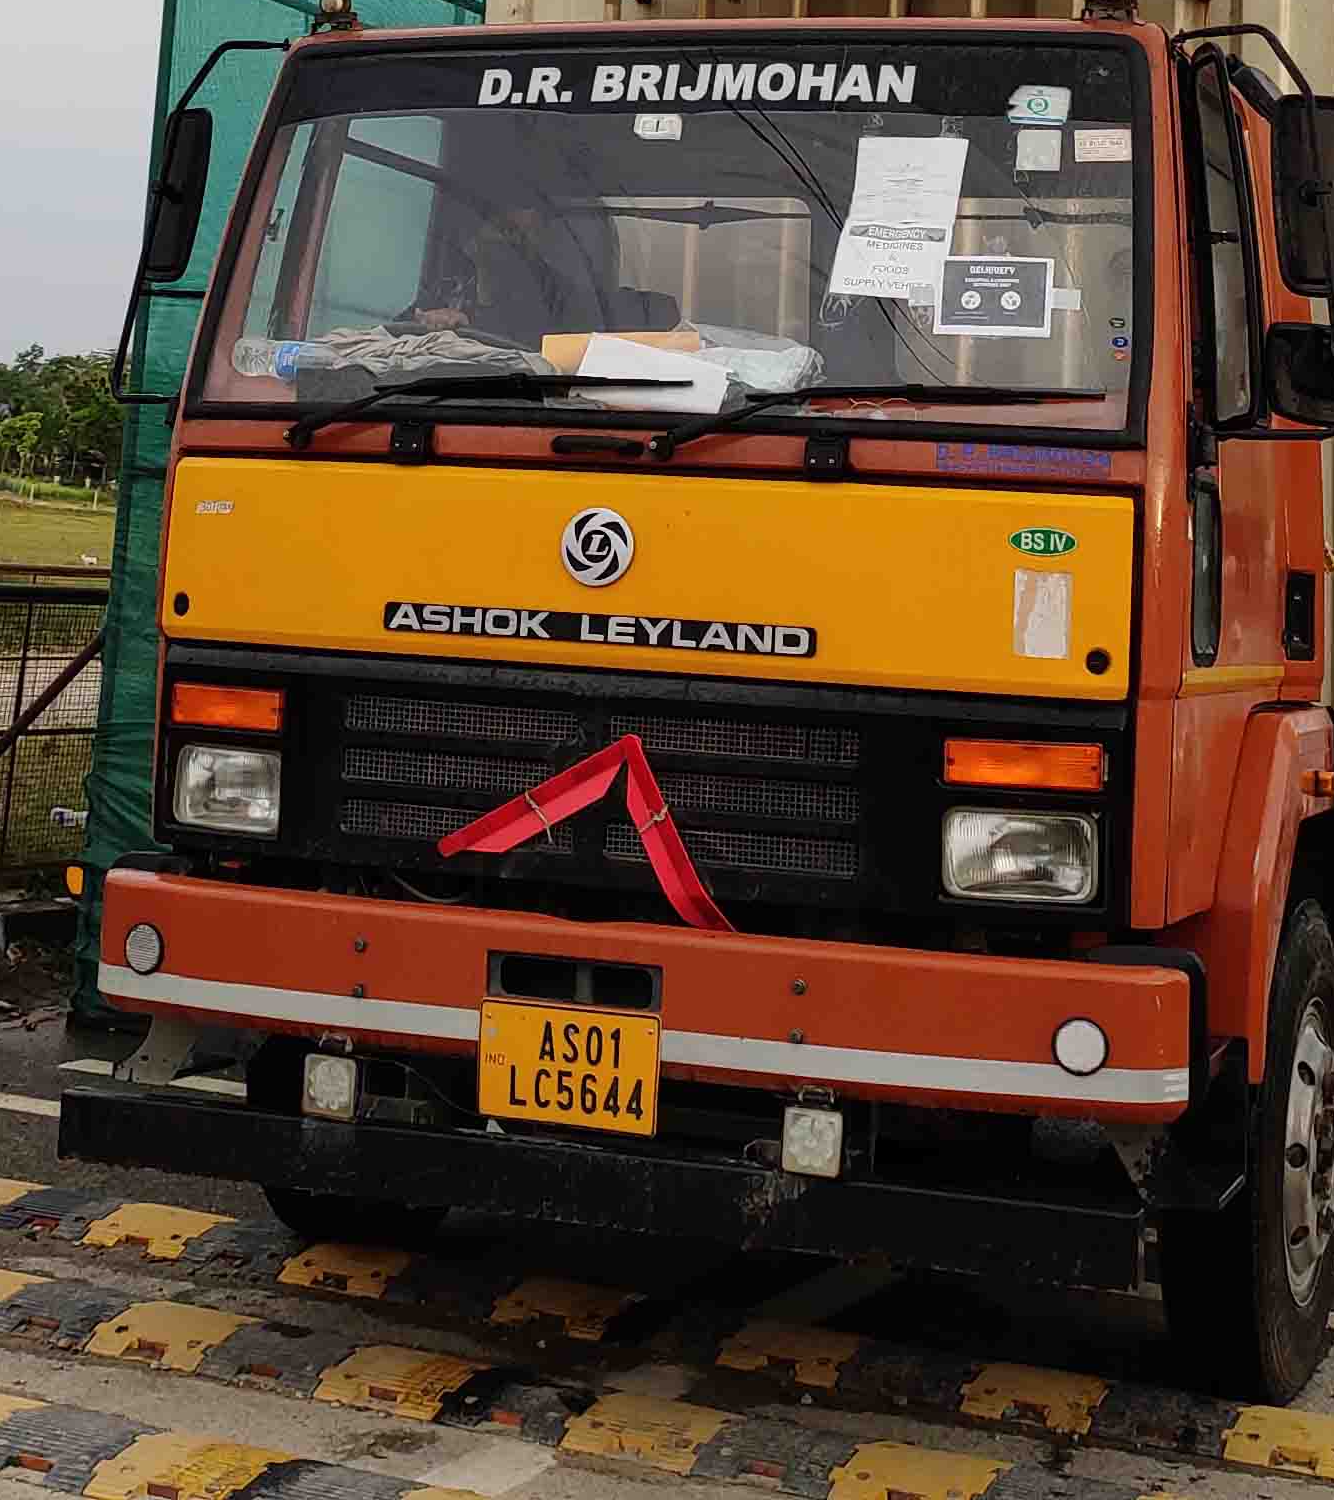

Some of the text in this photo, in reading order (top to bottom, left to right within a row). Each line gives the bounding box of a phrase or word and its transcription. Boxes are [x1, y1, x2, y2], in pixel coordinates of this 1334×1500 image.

[477, 62, 917, 105] D.R. BRIJMOHAN
[866, 240, 924, 251] MEDICINES
[867, 226, 926, 239] EMERGENCY
[1021, 532, 1068, 552] BS IV
[388, 602, 811, 656] ASHOK LEYLAND
[484, 1052, 507, 1066] IND
[538, 1019, 622, 1069] AS01
[509, 1064, 644, 1121] LC5644
